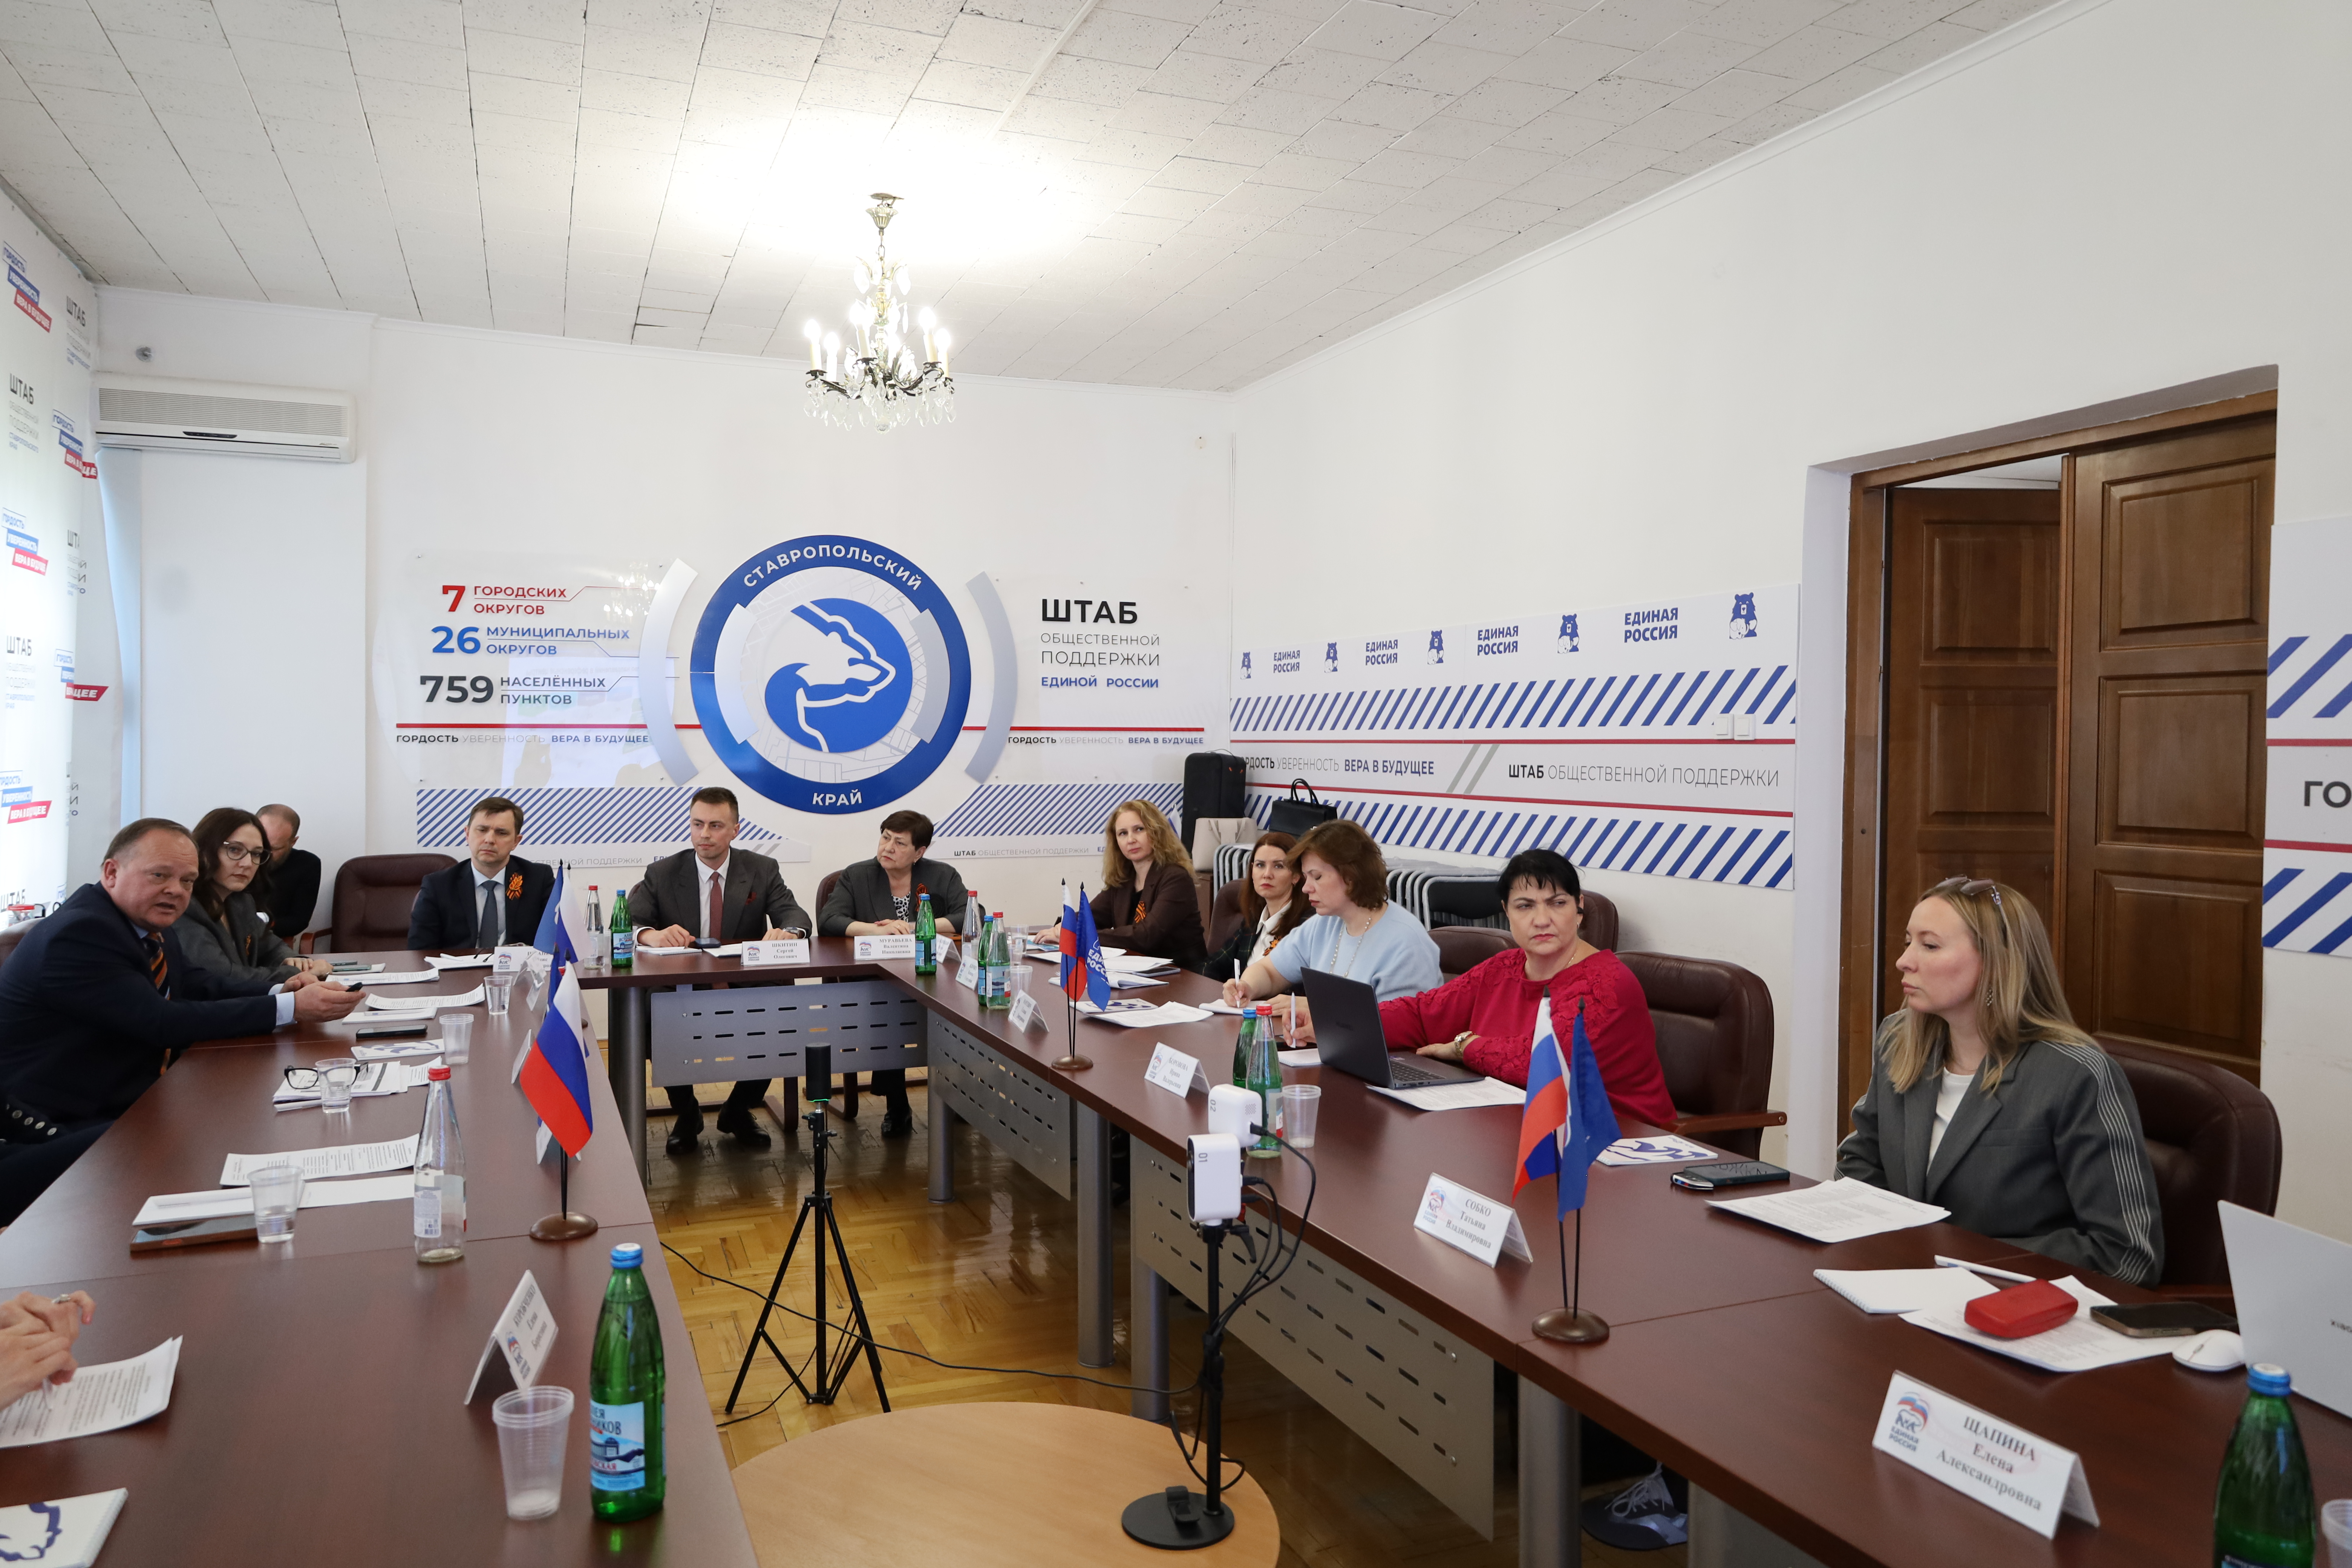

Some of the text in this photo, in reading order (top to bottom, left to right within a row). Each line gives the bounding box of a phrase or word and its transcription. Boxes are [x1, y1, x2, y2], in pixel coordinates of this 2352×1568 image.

[66, 295, 86, 327] ШТАБ
[10, 373, 34, 405] ШТАБ
[744, 544, 923, 591] СТАВРОПОЛЬСКИЙ
[442, 585, 567, 612] 7 ГОРОДСКИХ
[474, 603, 545, 615] ОКРУГОВ
[1042, 599, 1138, 624] ШТАБ
[1625, 607, 1678, 626] ЕДИНАЯ
[432, 626, 630, 654] 26 МУНИЦИПАЛЬНЫХ
[1041, 633, 1159, 646] ОБЩЕСТВЕННОЙ
[1478, 625, 1519, 641] ЕДИНАЯ
[1624, 625, 1678, 643] РОССИЯ
[7, 635, 32, 656] ШТАБ
[487, 644, 557, 655] ОКРУГОВ
[1366, 639, 1398, 652] ЕДИНАЯ
[1477, 641, 1518, 656] РОССИЯ
[1042, 651, 1159, 667] ПОДДЕРЖКИ
[1274, 650, 1300, 662] ЕДИНАЯ
[1365, 652, 1398, 666] РОССИЯ
[1273, 662, 1300, 674] РОССИЯ
[420, 675, 606, 703] 759 НАСЕЛЁННЫХ
[1041, 675, 1158, 688] ЕДИНОЙ РОССИИ
[501, 694, 572, 705] ПУНКТОВ
[397, 735, 459, 744] ГОРДОСТЬ
[462, 734, 545, 743] УВЕРЕННОСТЬ
[551, 735, 580, 743] ВЕРА
[595, 735, 649, 744] БУДУЩЕЕ
[1242, 756, 1434, 776] ОРДОСТЬ УВЕРЕННОСТЬ ВЕРА В БУДУЩЕЕ
[1508, 764, 1778, 788] ШТАБ ОБЩЕСТВЕННОЙ ПОДДЕРЖКИ
[812, 789, 862, 806] КРАЙ
[587, 858, 642, 866] ПОДДЕРЖКИ
[1210, 1099, 1216, 1112] 02
[1465, 1199, 1491, 1217] СОБКО
[1460, 1211, 1486, 1230] Татьяна
[1446, 1219, 1491, 1248] Владимировна
[1889, 1433, 1917, 1452] РОССИЯ
[1891, 1426, 1919, 1444] ЕДИНАЯ
[1963, 1416, 2035, 1461] ЩАПИНА
[1973, 1442, 2014, 1473] Елена
[1936, 1449, 2041, 1511] Александровна
